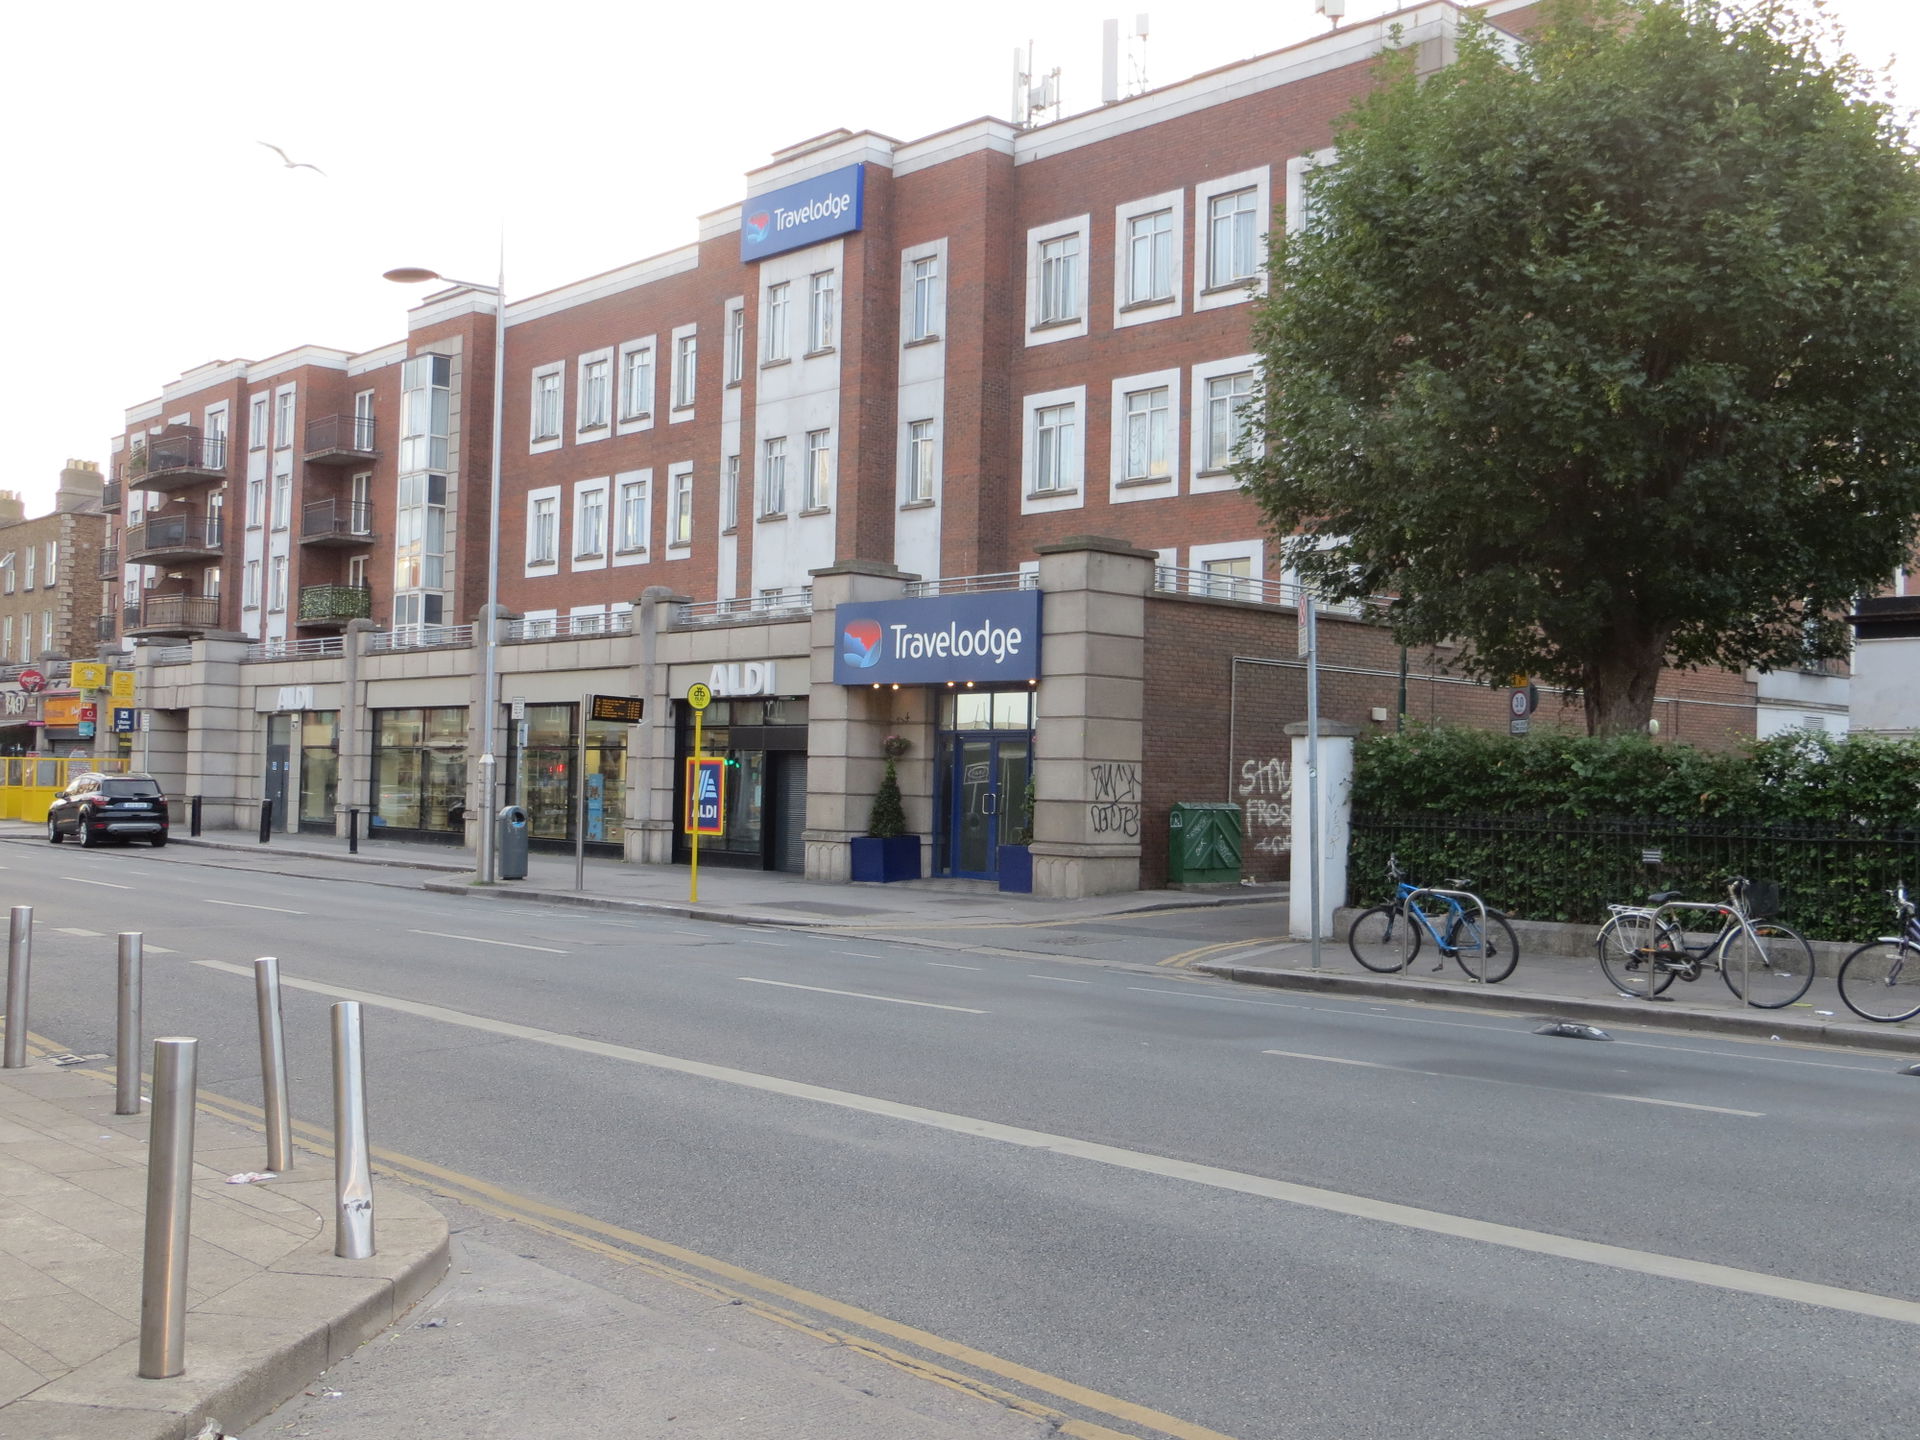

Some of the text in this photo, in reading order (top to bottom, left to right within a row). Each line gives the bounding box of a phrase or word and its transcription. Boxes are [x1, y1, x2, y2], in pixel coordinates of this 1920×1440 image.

[774, 192, 850, 231] Travelodge
[890, 619, 1022, 664] Travelodge
[709, 661, 775, 696] ALDI
[277, 686, 313, 711] ALDI
